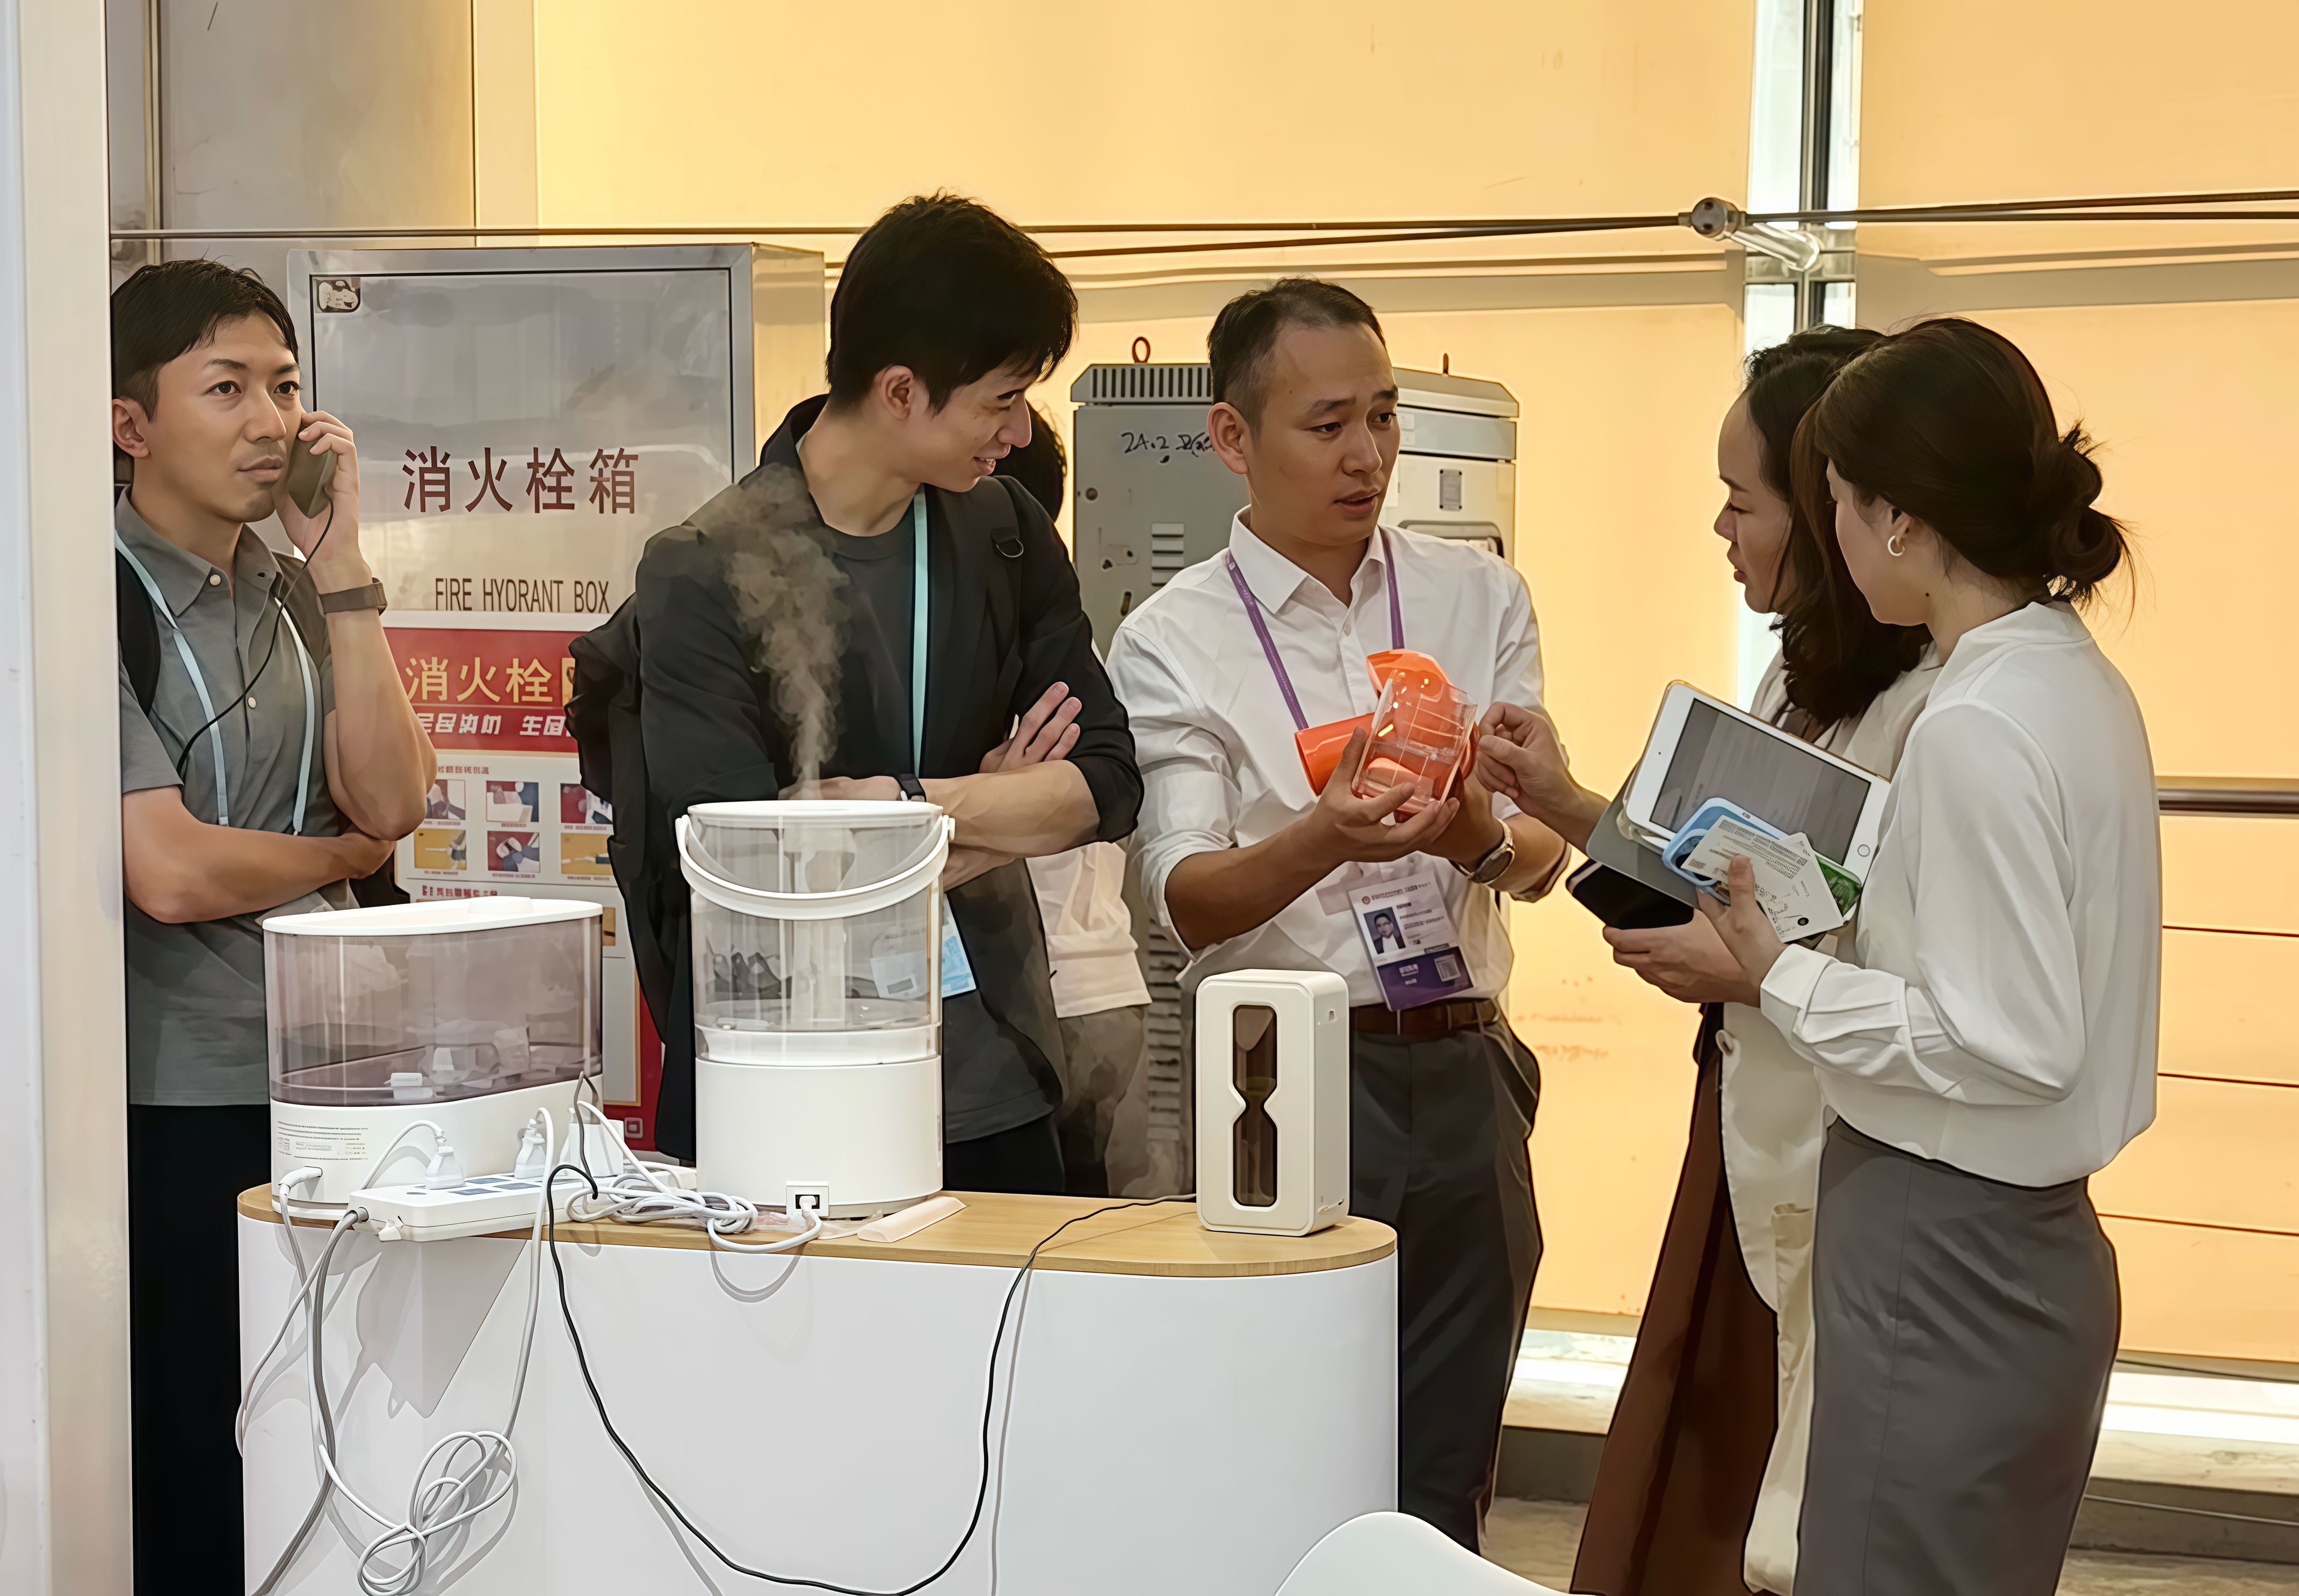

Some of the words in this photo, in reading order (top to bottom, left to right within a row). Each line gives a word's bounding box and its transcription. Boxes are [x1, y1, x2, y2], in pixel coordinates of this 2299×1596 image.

[402, 446, 639, 514] 消火栓箱
[436, 578, 472, 611] FIRE
[574, 581, 610, 613] BOX
